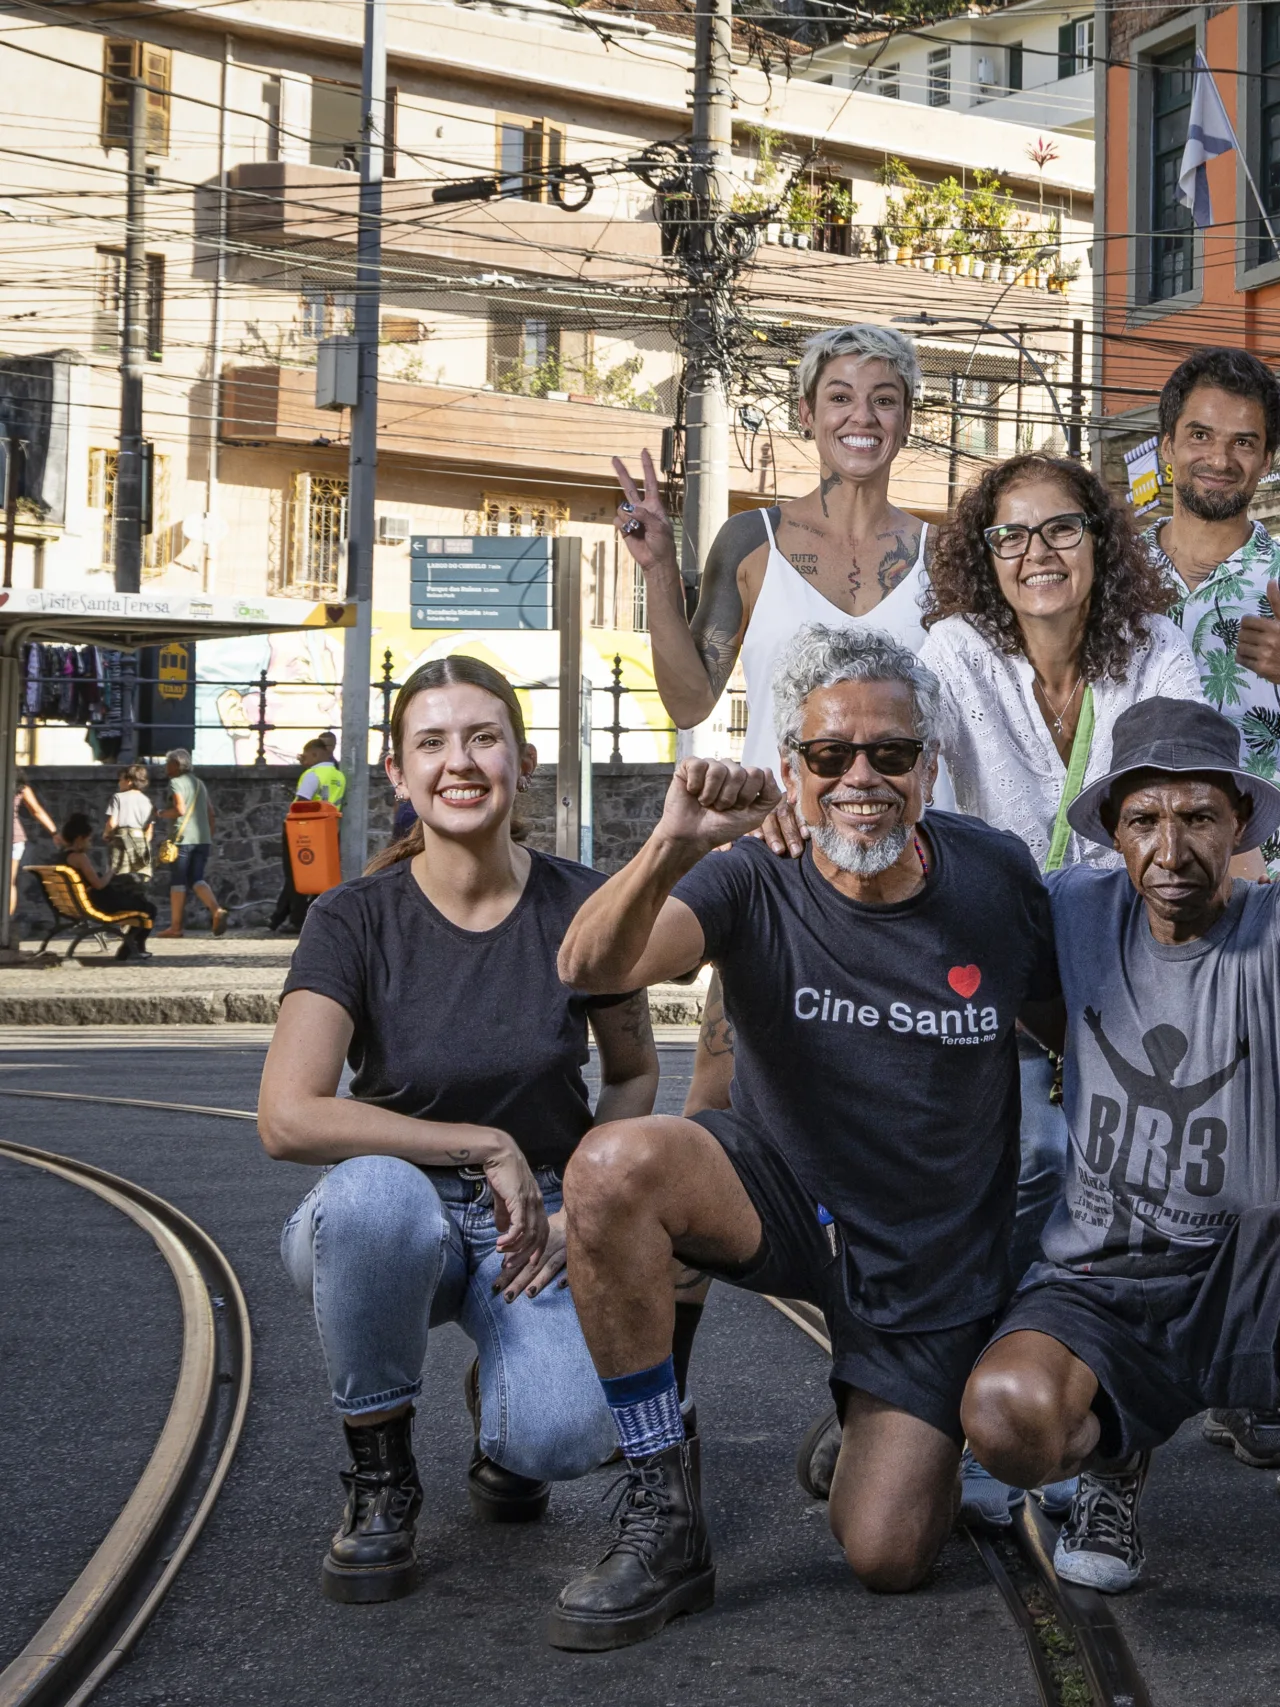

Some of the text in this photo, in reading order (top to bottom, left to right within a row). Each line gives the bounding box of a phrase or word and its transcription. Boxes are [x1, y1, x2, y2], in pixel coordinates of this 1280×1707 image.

[790, 553, 818, 564] TUTTO
[794, 987, 999, 1035] Cine Santa
[1086, 1093, 1228, 1198] BR3
